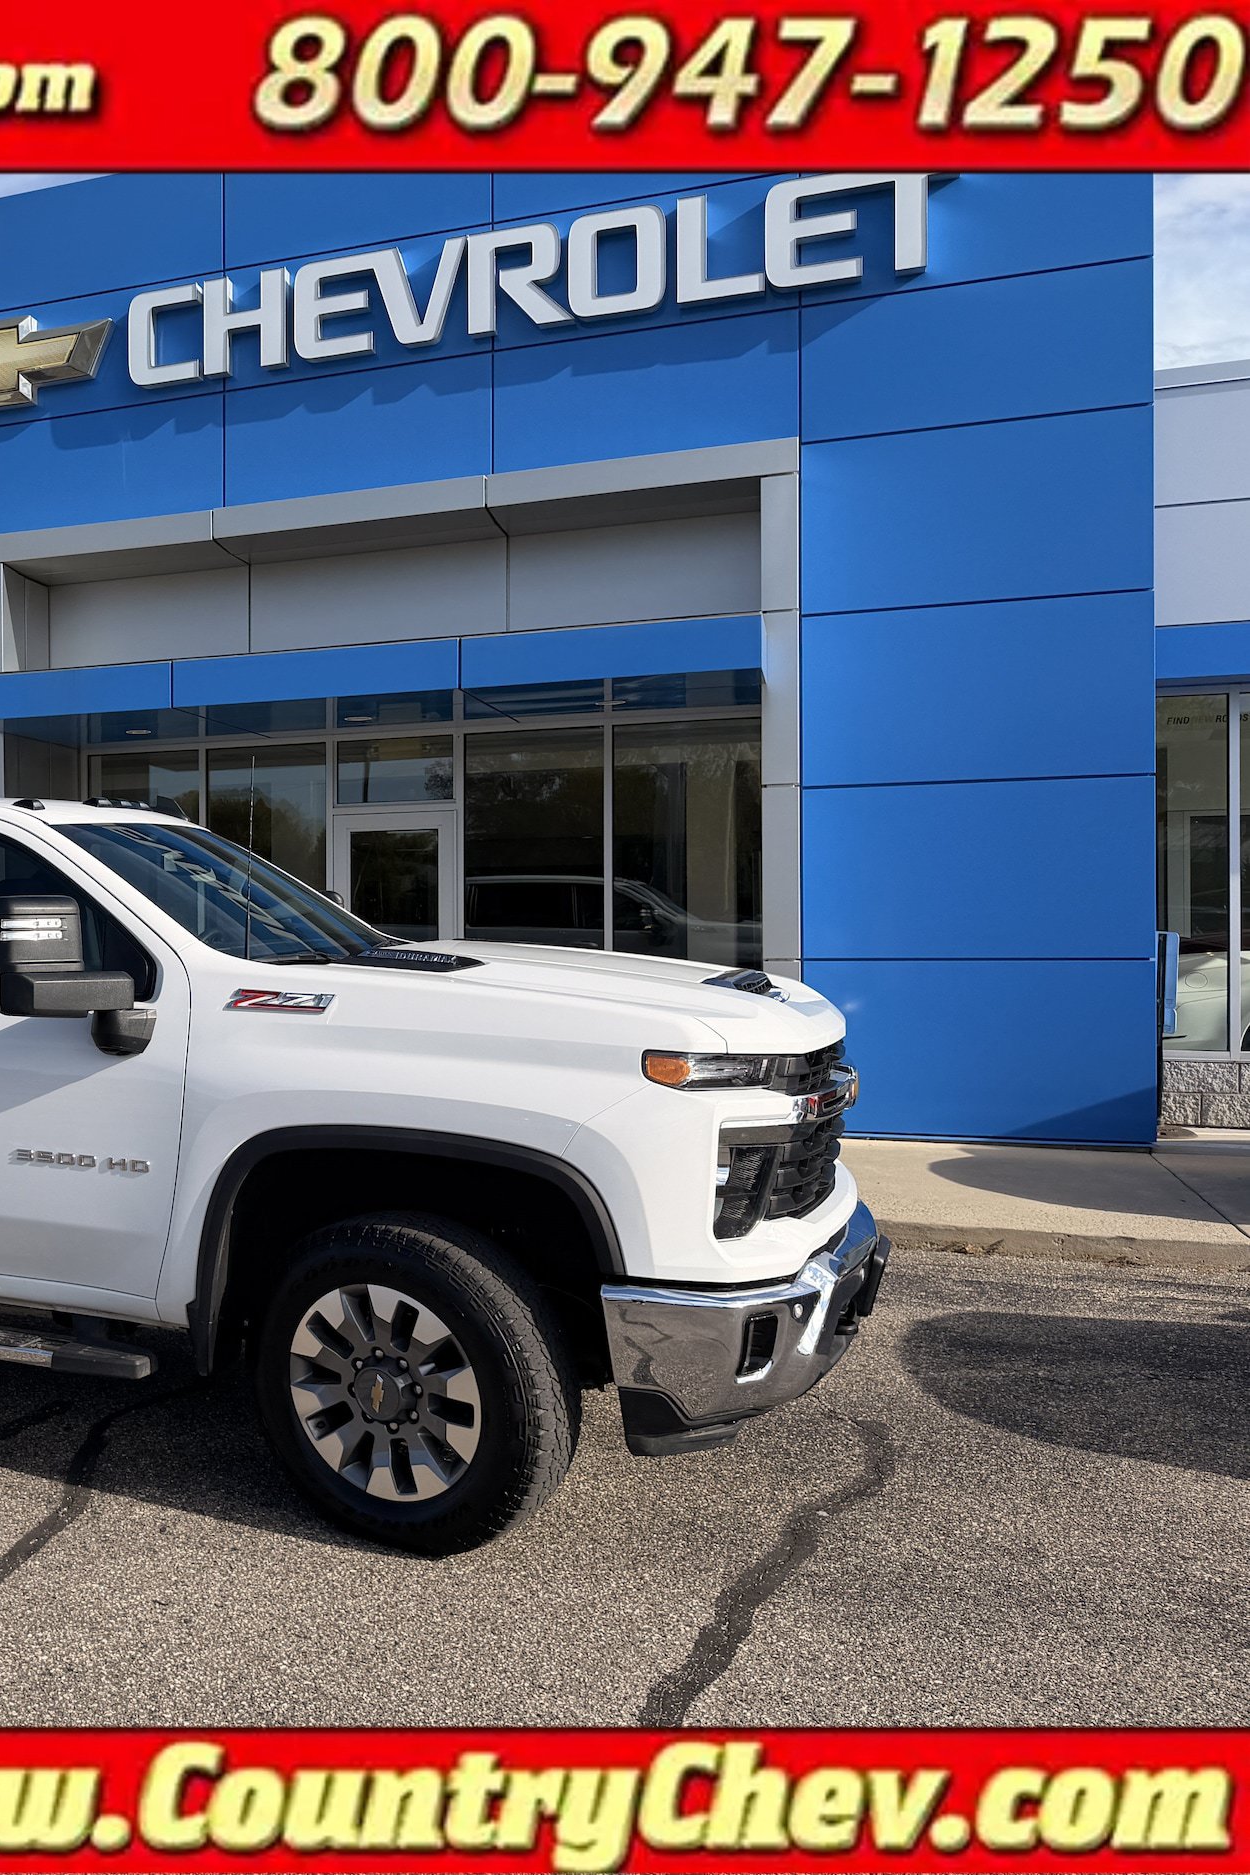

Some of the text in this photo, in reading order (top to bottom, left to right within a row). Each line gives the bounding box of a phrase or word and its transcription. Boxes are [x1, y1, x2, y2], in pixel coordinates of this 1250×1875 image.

[127, 173, 929, 387] CHEVROLET
[1167, 716, 1190, 725] FIND
[224, 988, 334, 1014] Z71
[107, 1157, 150, 1173] HD
